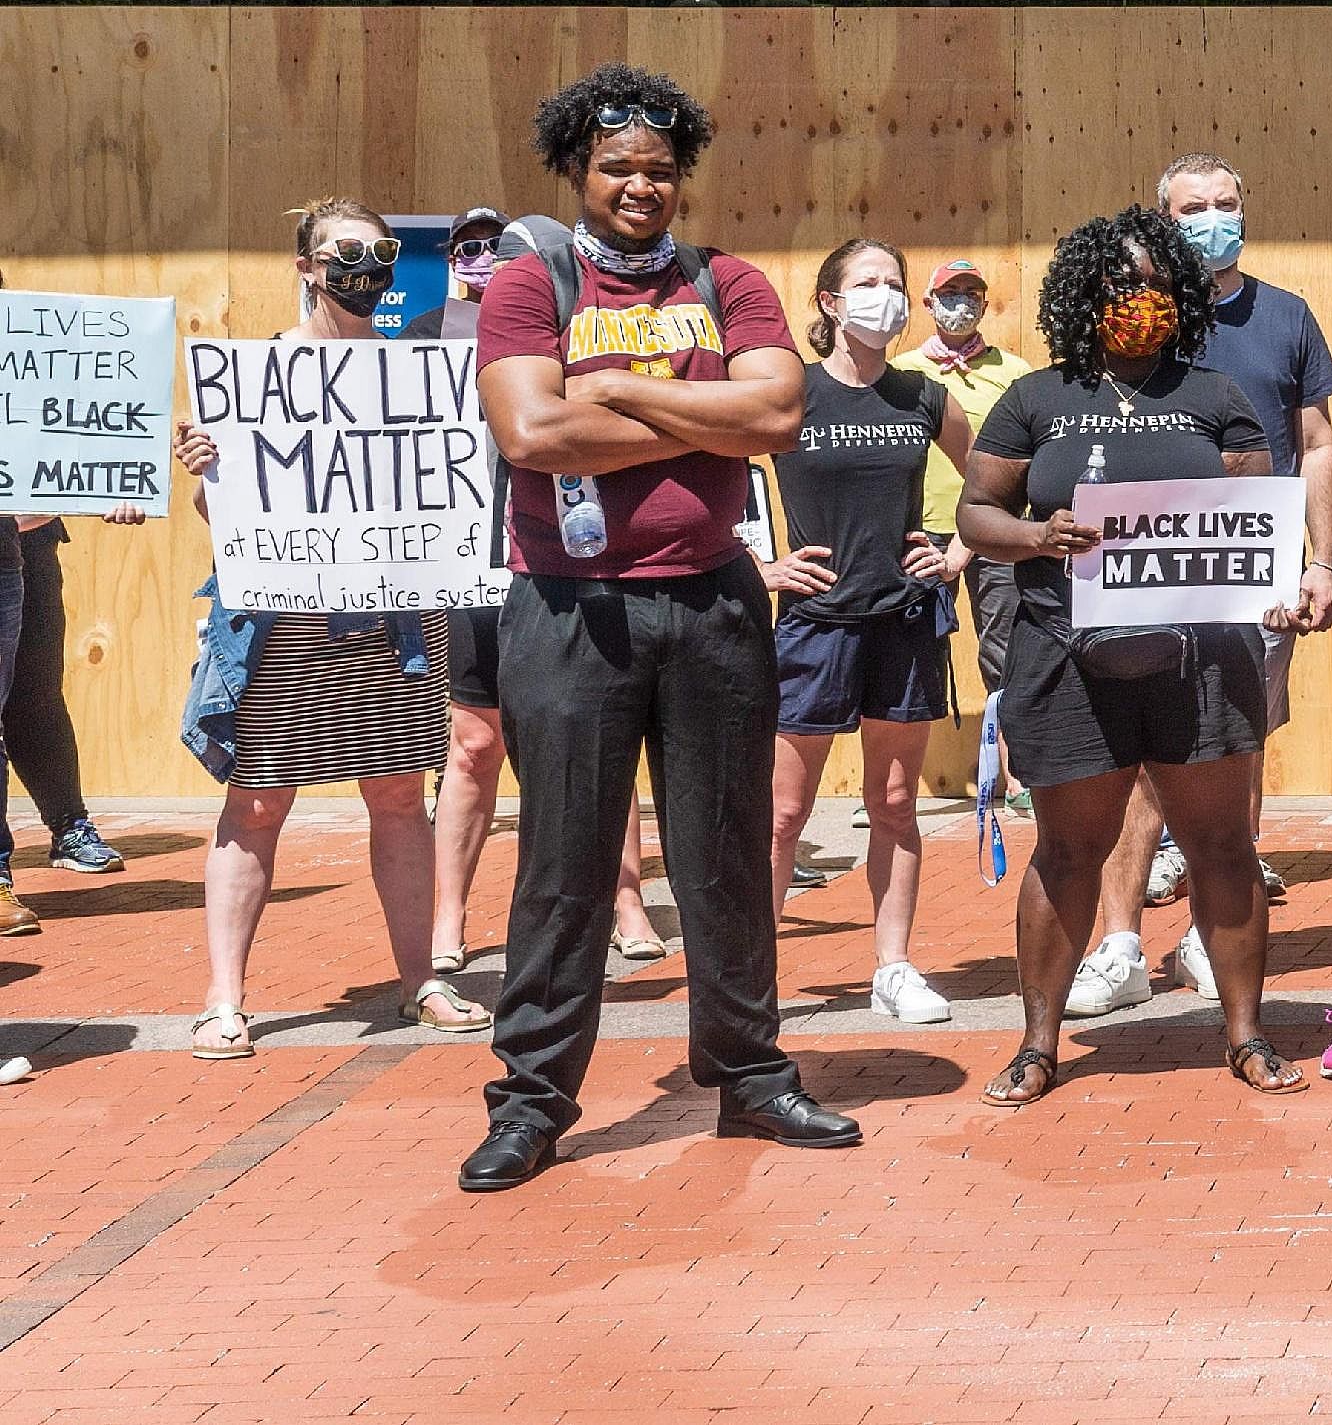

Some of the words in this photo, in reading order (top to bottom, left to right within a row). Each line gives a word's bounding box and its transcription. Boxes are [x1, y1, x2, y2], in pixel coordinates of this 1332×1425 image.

[7, 306, 130, 337] LIVES
[372, 314, 402, 328] ess
[190, 343, 358, 425] BLACK
[378, 345, 488, 424] LIV
[42, 397, 150, 433] BLACK
[829, 424, 924, 439] HENNEPIN
[1079, 413, 1195, 428] HENNEPIN
[31, 459, 161, 495] MATTER
[252, 428, 485, 514] MATTER
[224, 527, 246, 558] at
[255, 526, 341, 564] EVERY
[361, 523, 442, 562] STEP
[457, 522, 481, 557] of
[1103, 513, 1191, 541] BLACK
[1198, 512, 1274, 538] LIVES
[1105, 552, 1272, 584] MATTER
[242, 573, 325, 609] criminal
[330, 575, 421, 612] justice
